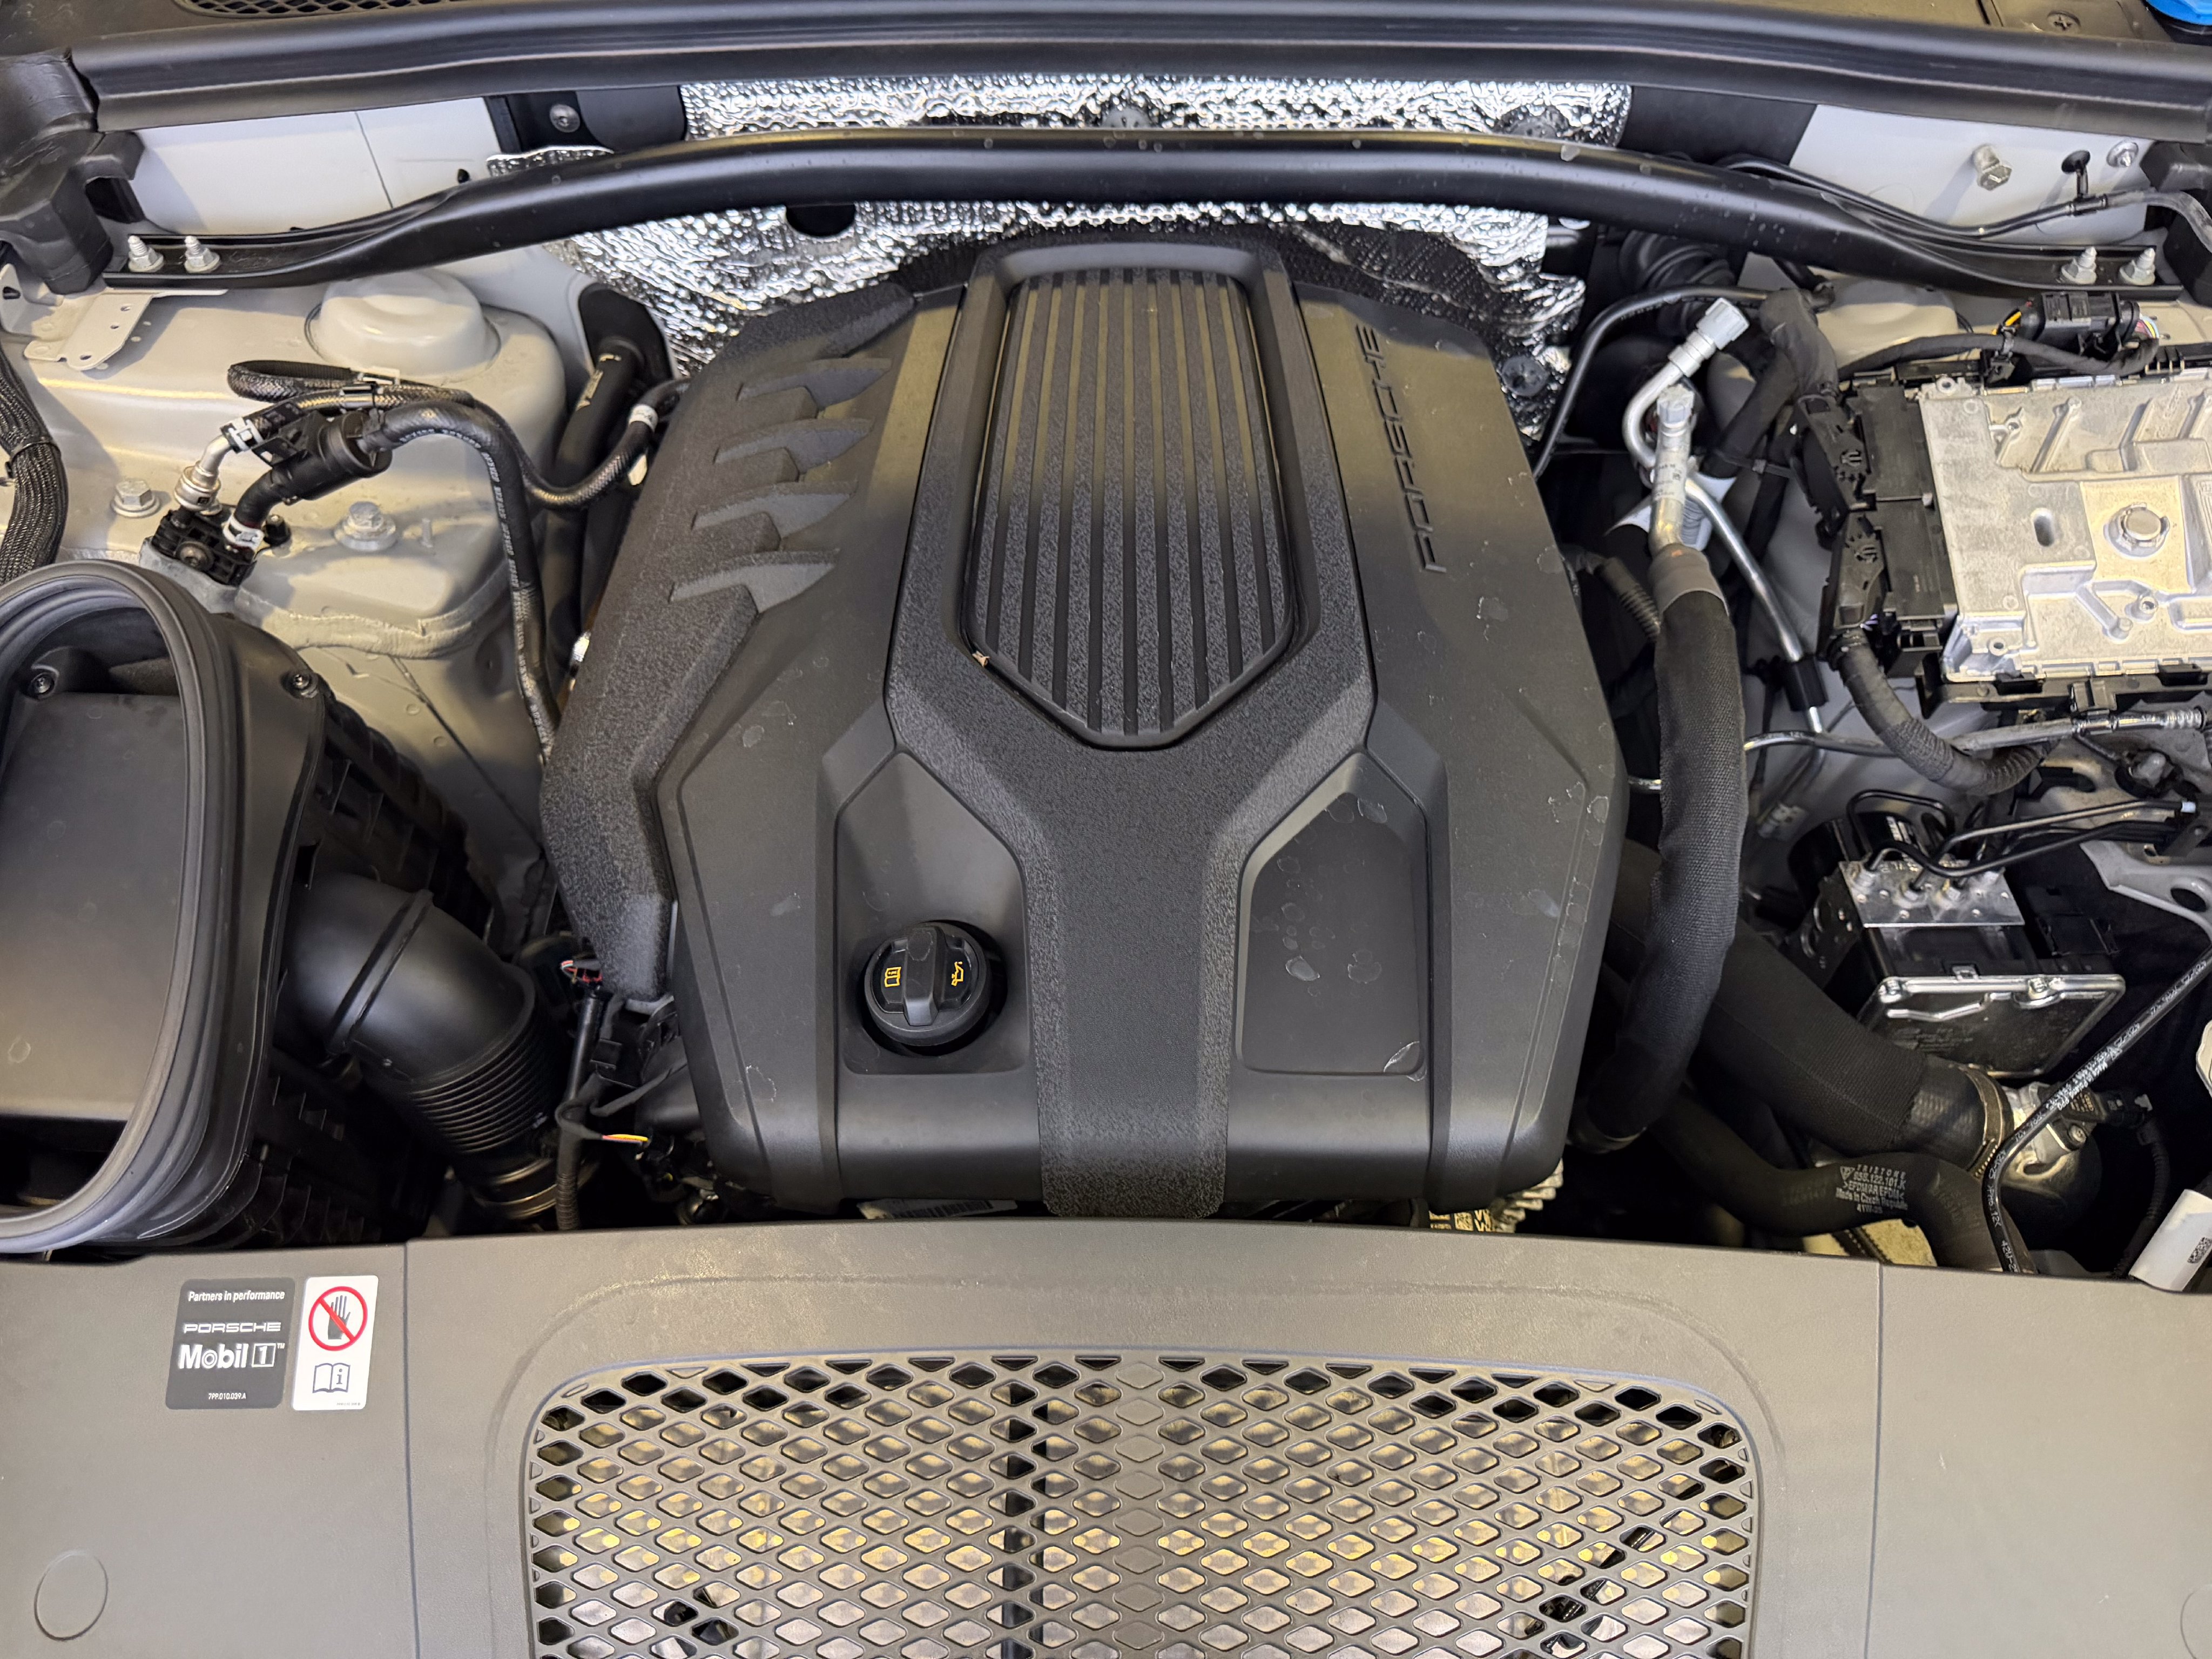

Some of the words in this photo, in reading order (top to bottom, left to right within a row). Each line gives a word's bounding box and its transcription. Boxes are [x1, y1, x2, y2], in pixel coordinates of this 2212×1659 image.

[1356, 323, 1447, 574] PORSCHE
[188, 1291, 222, 1301] Partners
[224, 1290, 232, 1301] in
[233, 1290, 285, 1303] performance
[184, 1322, 281, 1334] PORSCHE
[179, 1343, 249, 1369] Mobil
[208, 1392, 246, 1400] 7PP.010.039.A
